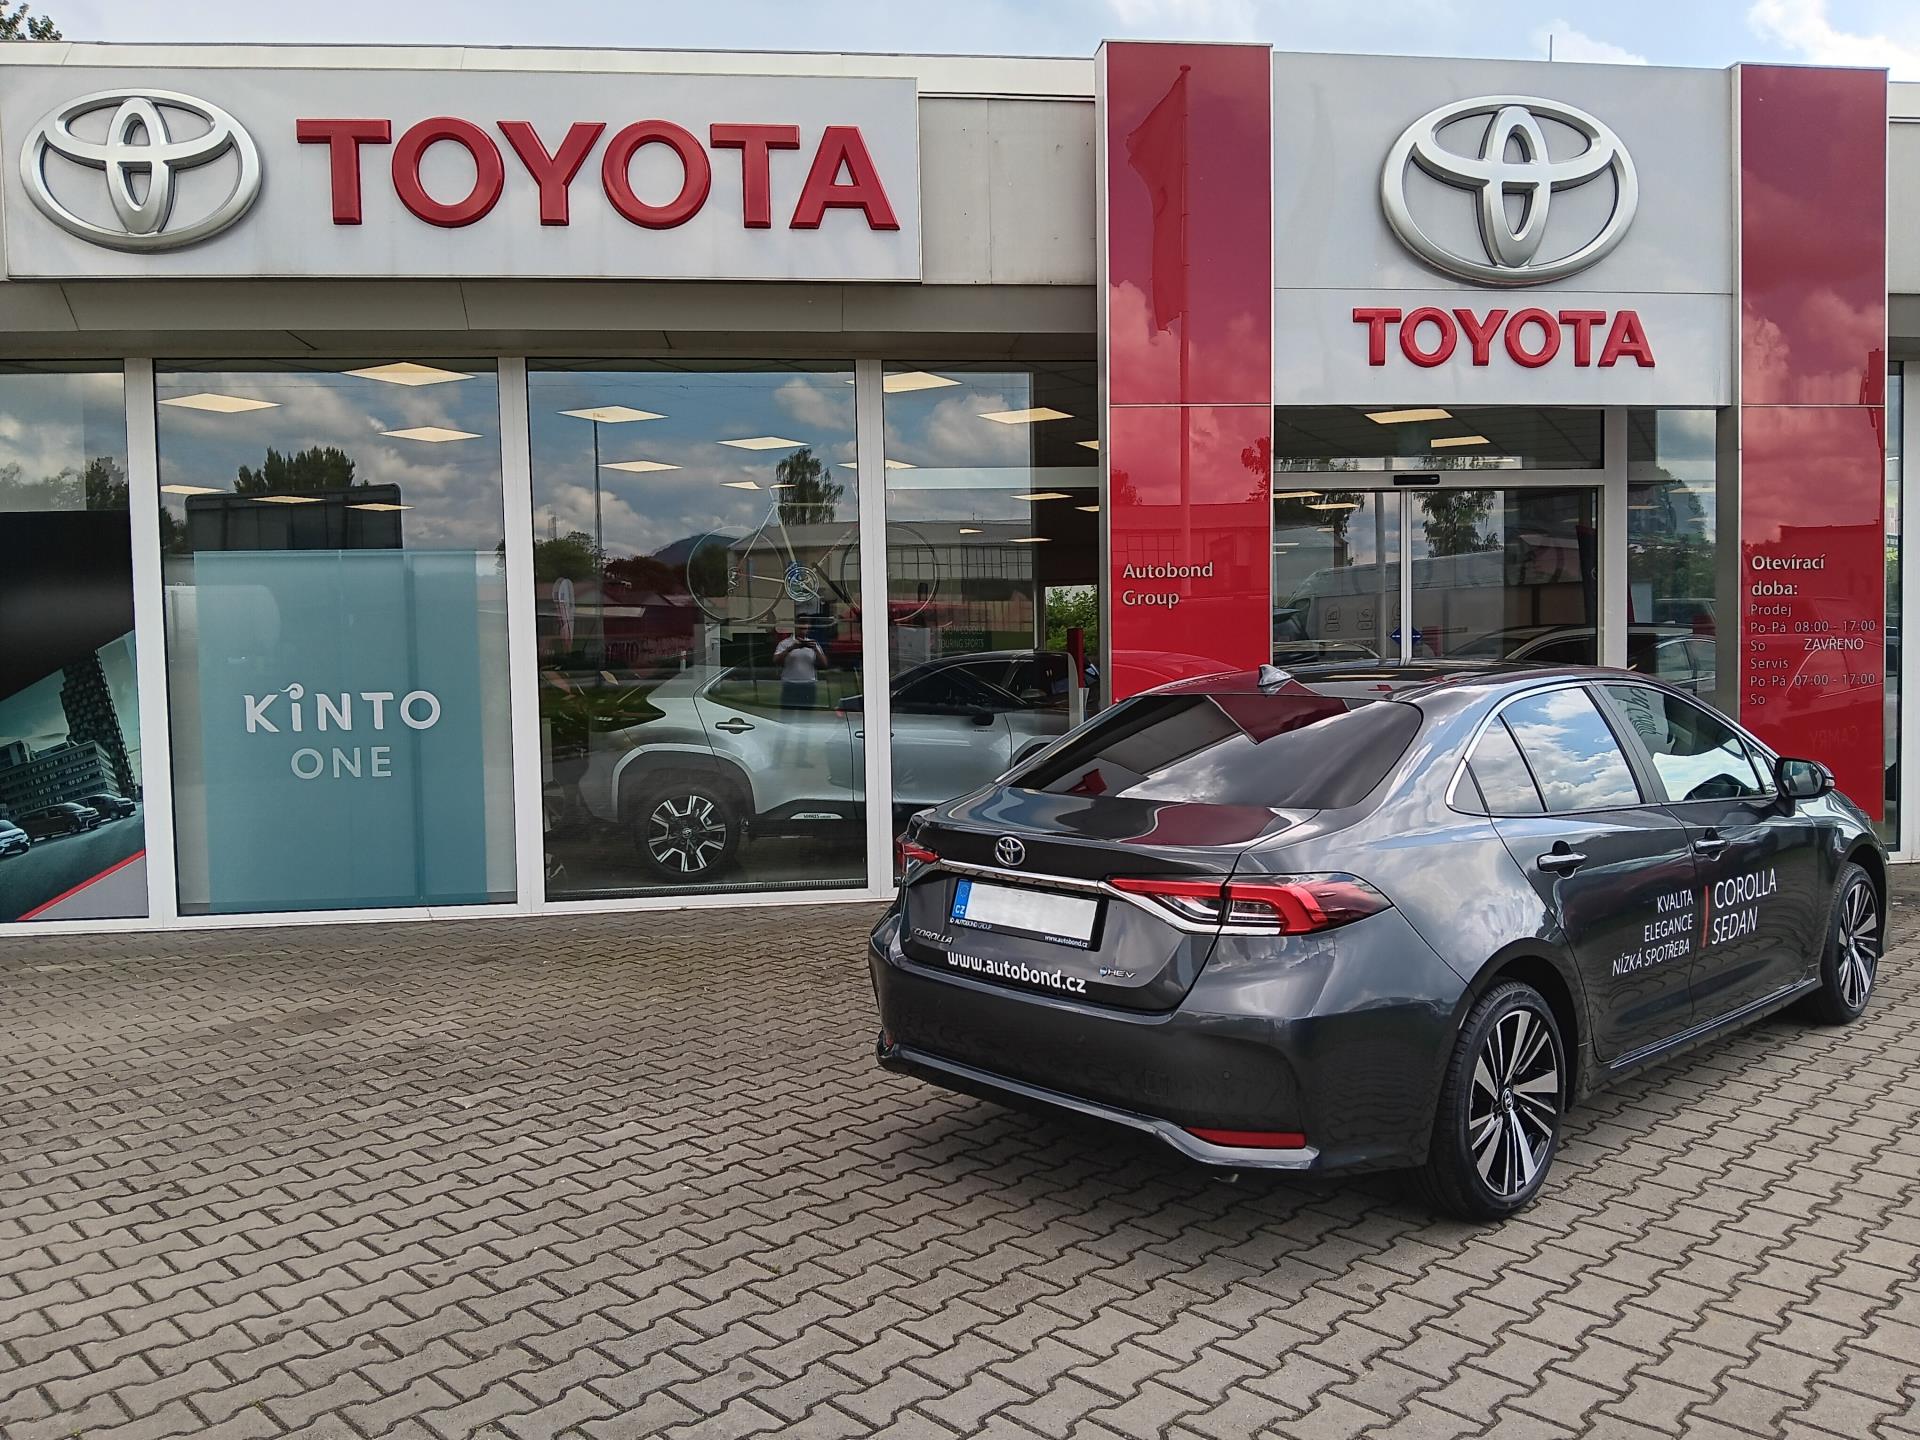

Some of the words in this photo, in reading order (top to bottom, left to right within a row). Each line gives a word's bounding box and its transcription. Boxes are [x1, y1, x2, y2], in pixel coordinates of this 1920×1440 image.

[296, 117, 900, 231] TOYOTA
[1352, 306, 1656, 368] TOYOTA
[1123, 561, 1213, 578] Autobond
[1752, 554, 1826, 570] Otevírací
[1752, 581, 1798, 595] doba:
[1122, 590, 1180, 609] Group
[1751, 604, 1792, 617] Prodej
[1795, 621, 1829, 632] 08:00
[1843, 620, 1876, 631] 17:00
[1750, 640, 1766, 651] So
[1804, 636, 1864, 650] ZAVŘENO
[1750, 658, 1789, 669] Servis
[1795, 675, 1829, 686] 07:00
[1843, 674, 1875, 684] 17:00
[1750, 694, 1766, 704] So
[291, 746, 392, 780] ONE
[1714, 867, 1777, 909] COROLLA
[955, 904, 966, 915] CZ
[1657, 889, 1693, 913] KVALITA
[1644, 913, 1693, 942] ELEGANCE
[1711, 905, 1758, 945] SEDAN
[914, 927, 953, 944] COROLLA
[1044, 935, 1089, 948] www.autobond.cz
[1612, 948, 1643, 976] NÍZKÁ
[1644, 938, 1690, 967] SPOTŘEBA
[947, 951, 1087, 993] www.autobond.cz
[1107, 969, 1136, 978] HEV
